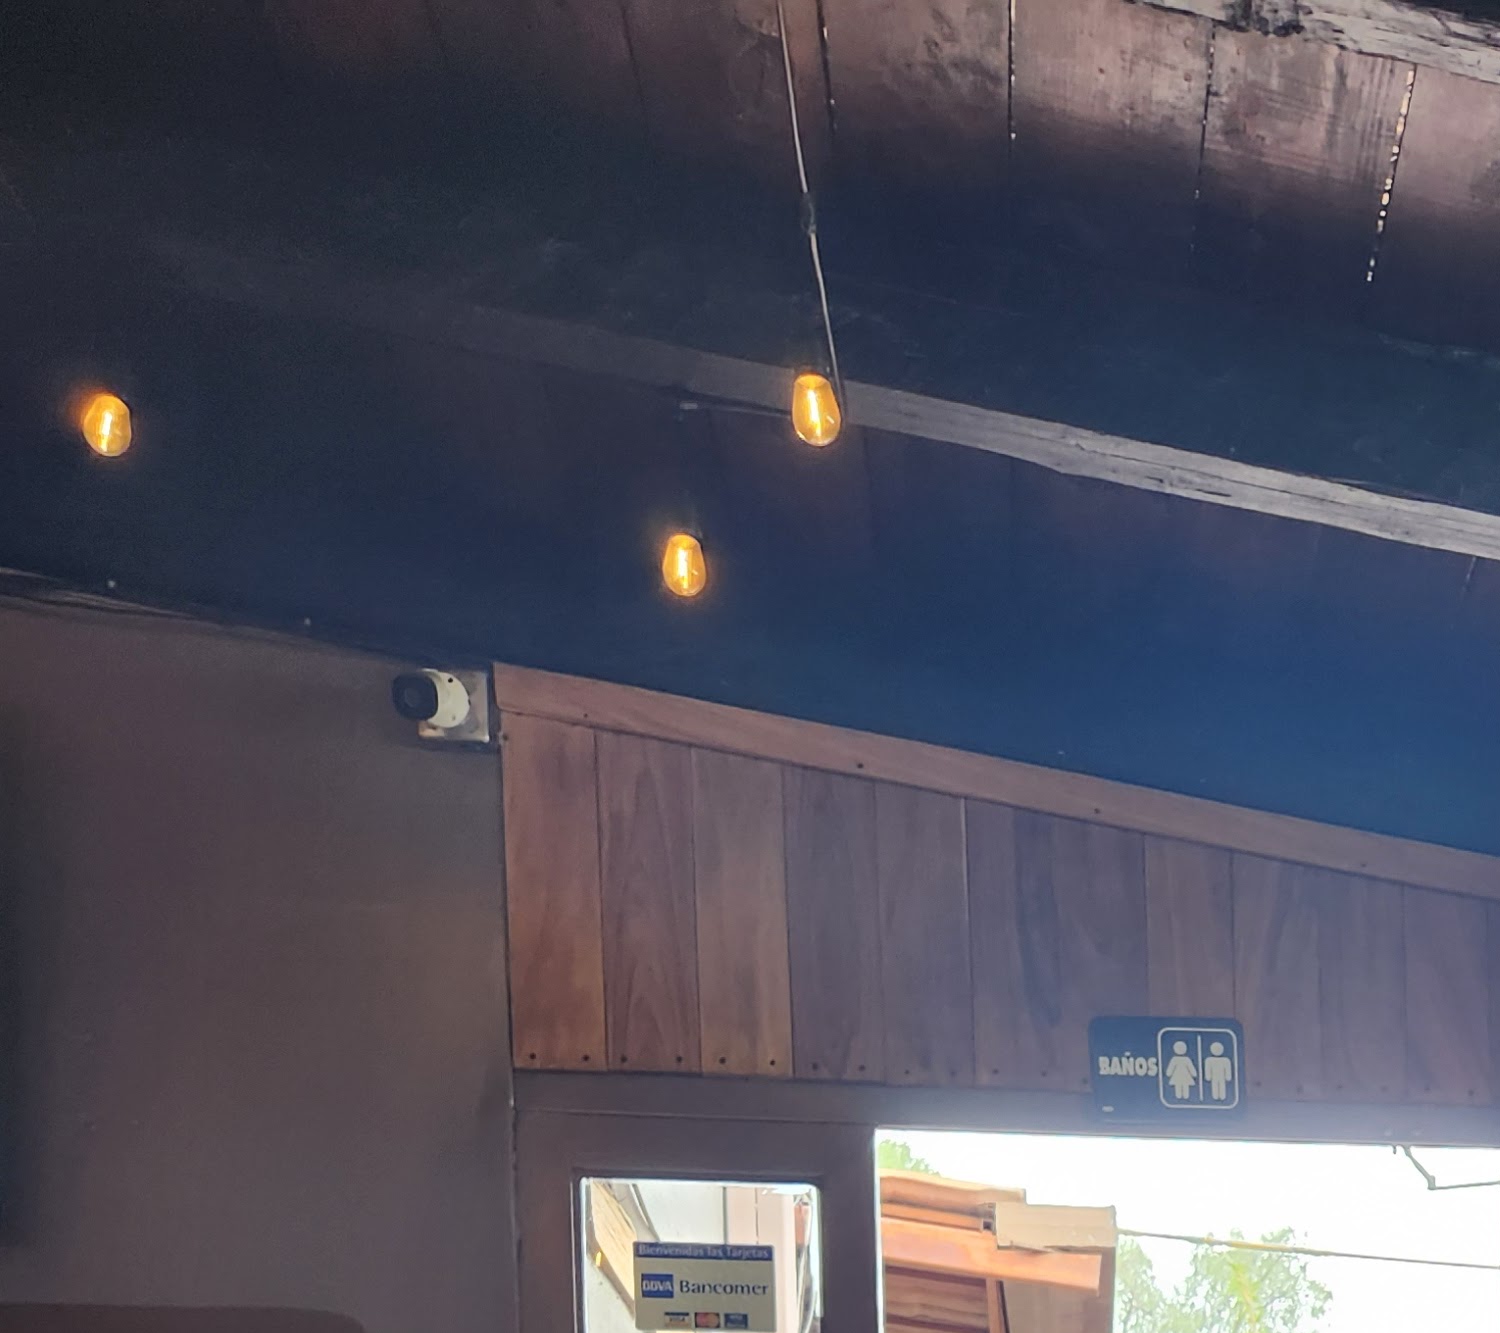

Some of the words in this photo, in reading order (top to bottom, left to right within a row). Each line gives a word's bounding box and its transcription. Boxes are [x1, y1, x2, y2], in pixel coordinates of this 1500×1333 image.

[1098, 1051, 1158, 1077] BAÑOS
[706, 1245, 723, 1258] las
[725, 1246, 769, 1260] Tarjetas
[642, 1279, 673, 1292] BBVA
[679, 1279, 769, 1296] Bancomer
